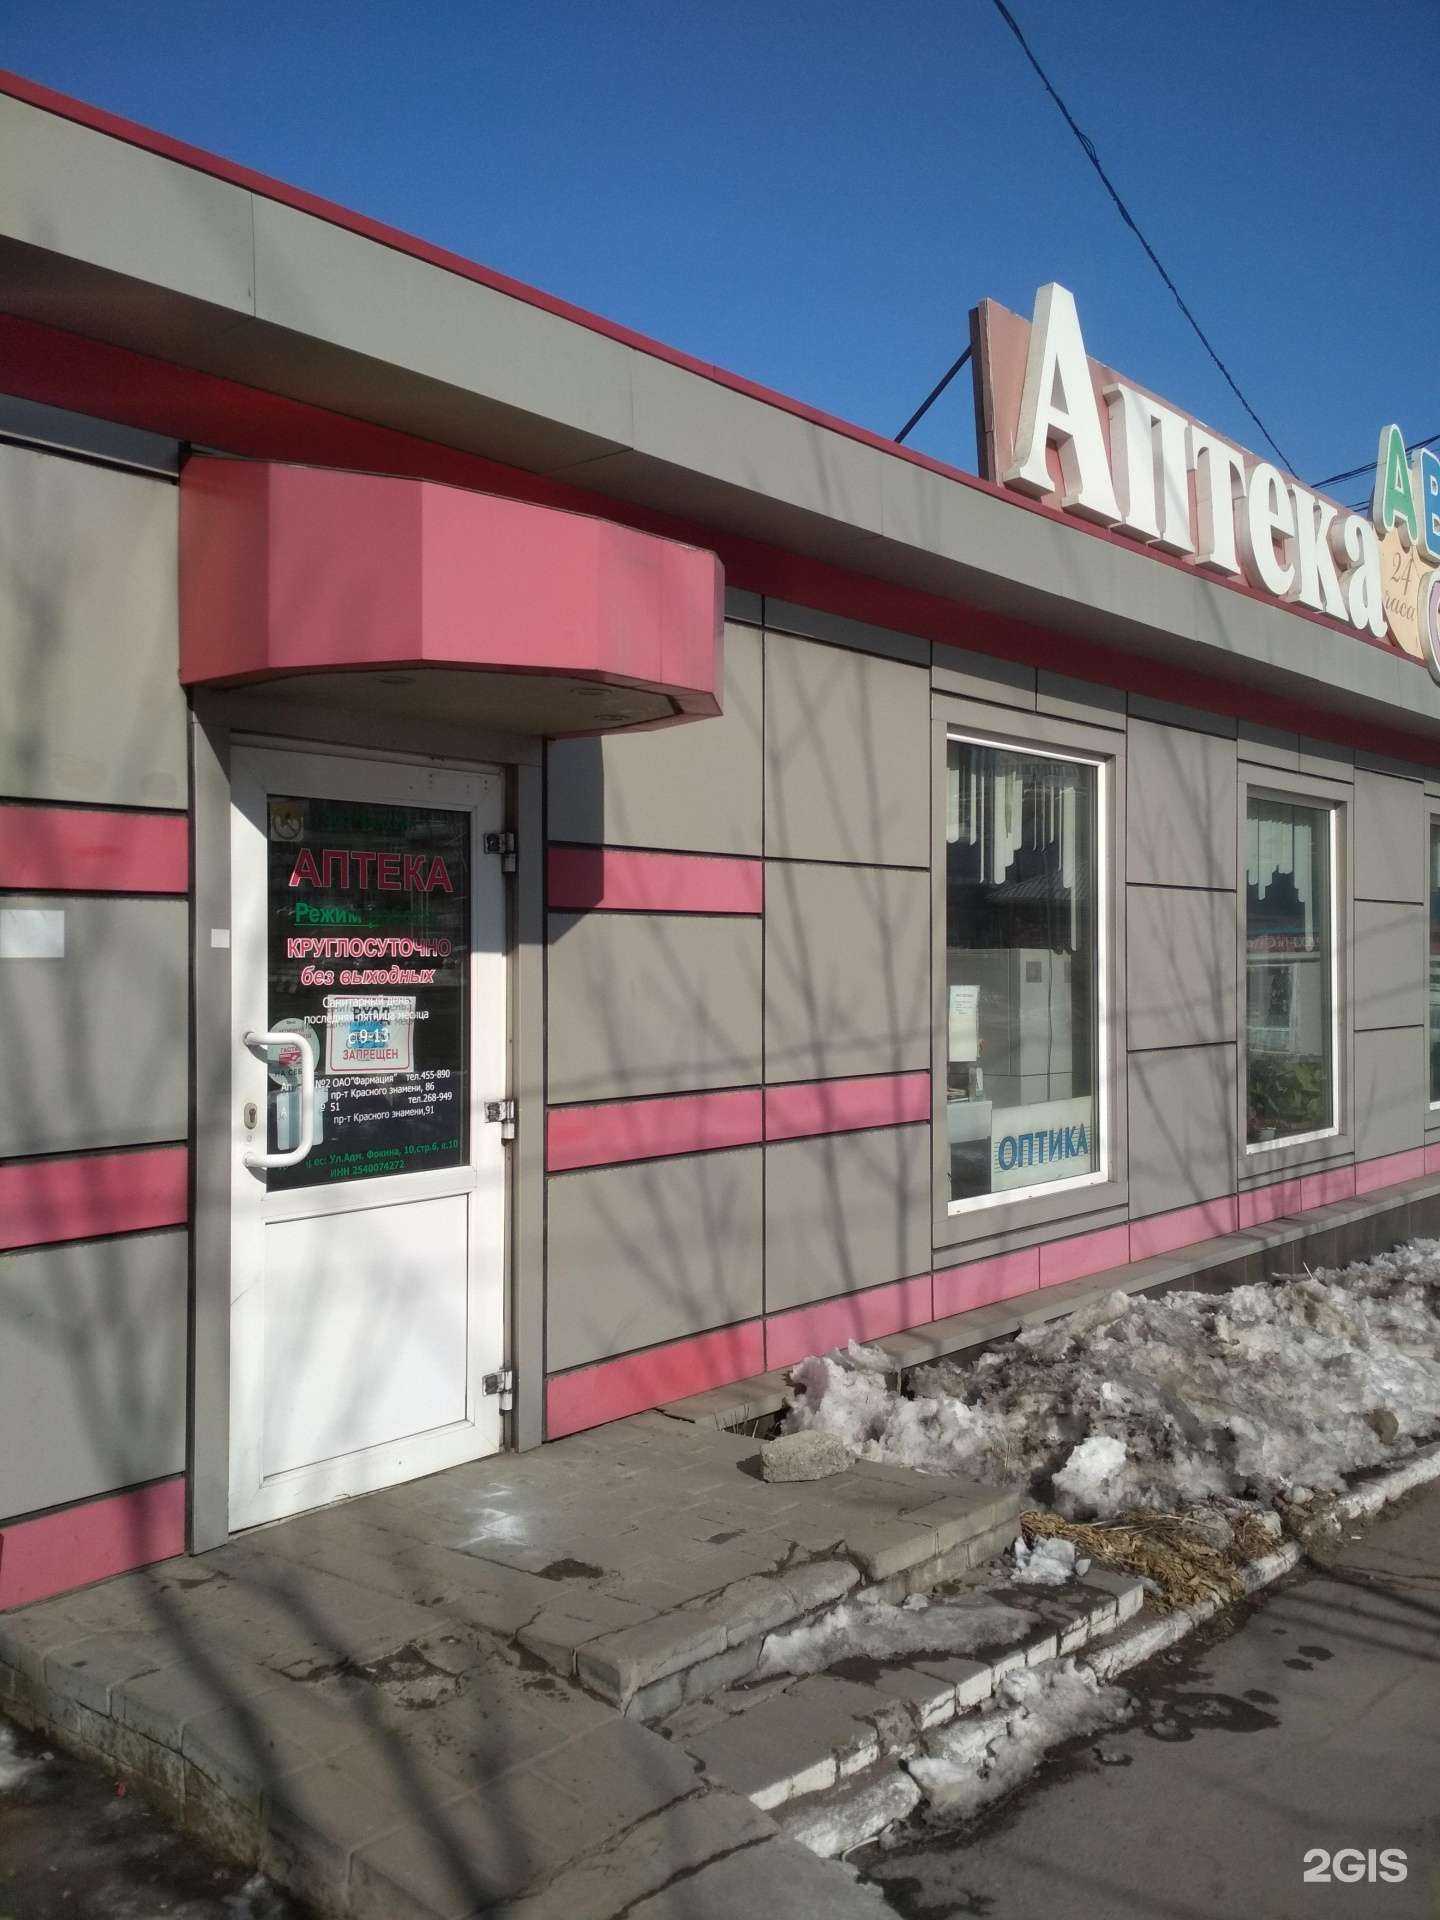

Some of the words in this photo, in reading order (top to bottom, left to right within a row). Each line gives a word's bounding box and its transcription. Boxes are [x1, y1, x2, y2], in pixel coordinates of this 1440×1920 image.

[1003, 282, 1387, 637] Аптека
[1392, 551, 1411, 596] 24
[288, 848, 455, 892] АПТЕКА
[295, 902, 362, 926] Режим
[287, 937, 451, 958] КРУГЛОСУТОЧНО
[301, 964, 335, 986] без
[340, 964, 436, 985] выходных
[322, 995, 387, 1009] Санитарный
[359, 1028, 390, 1043] 9-13
[343, 1049, 399, 1061] ЗАПРЕЩЕН
[350, 1086, 388, 1099] Красного
[425, 1081, 435, 1091] 86
[330, 1102, 340, 1112] 51
[353, 1110, 390, 1123] Красного
[1000, 1123, 1088, 1171] ОПТИКА
